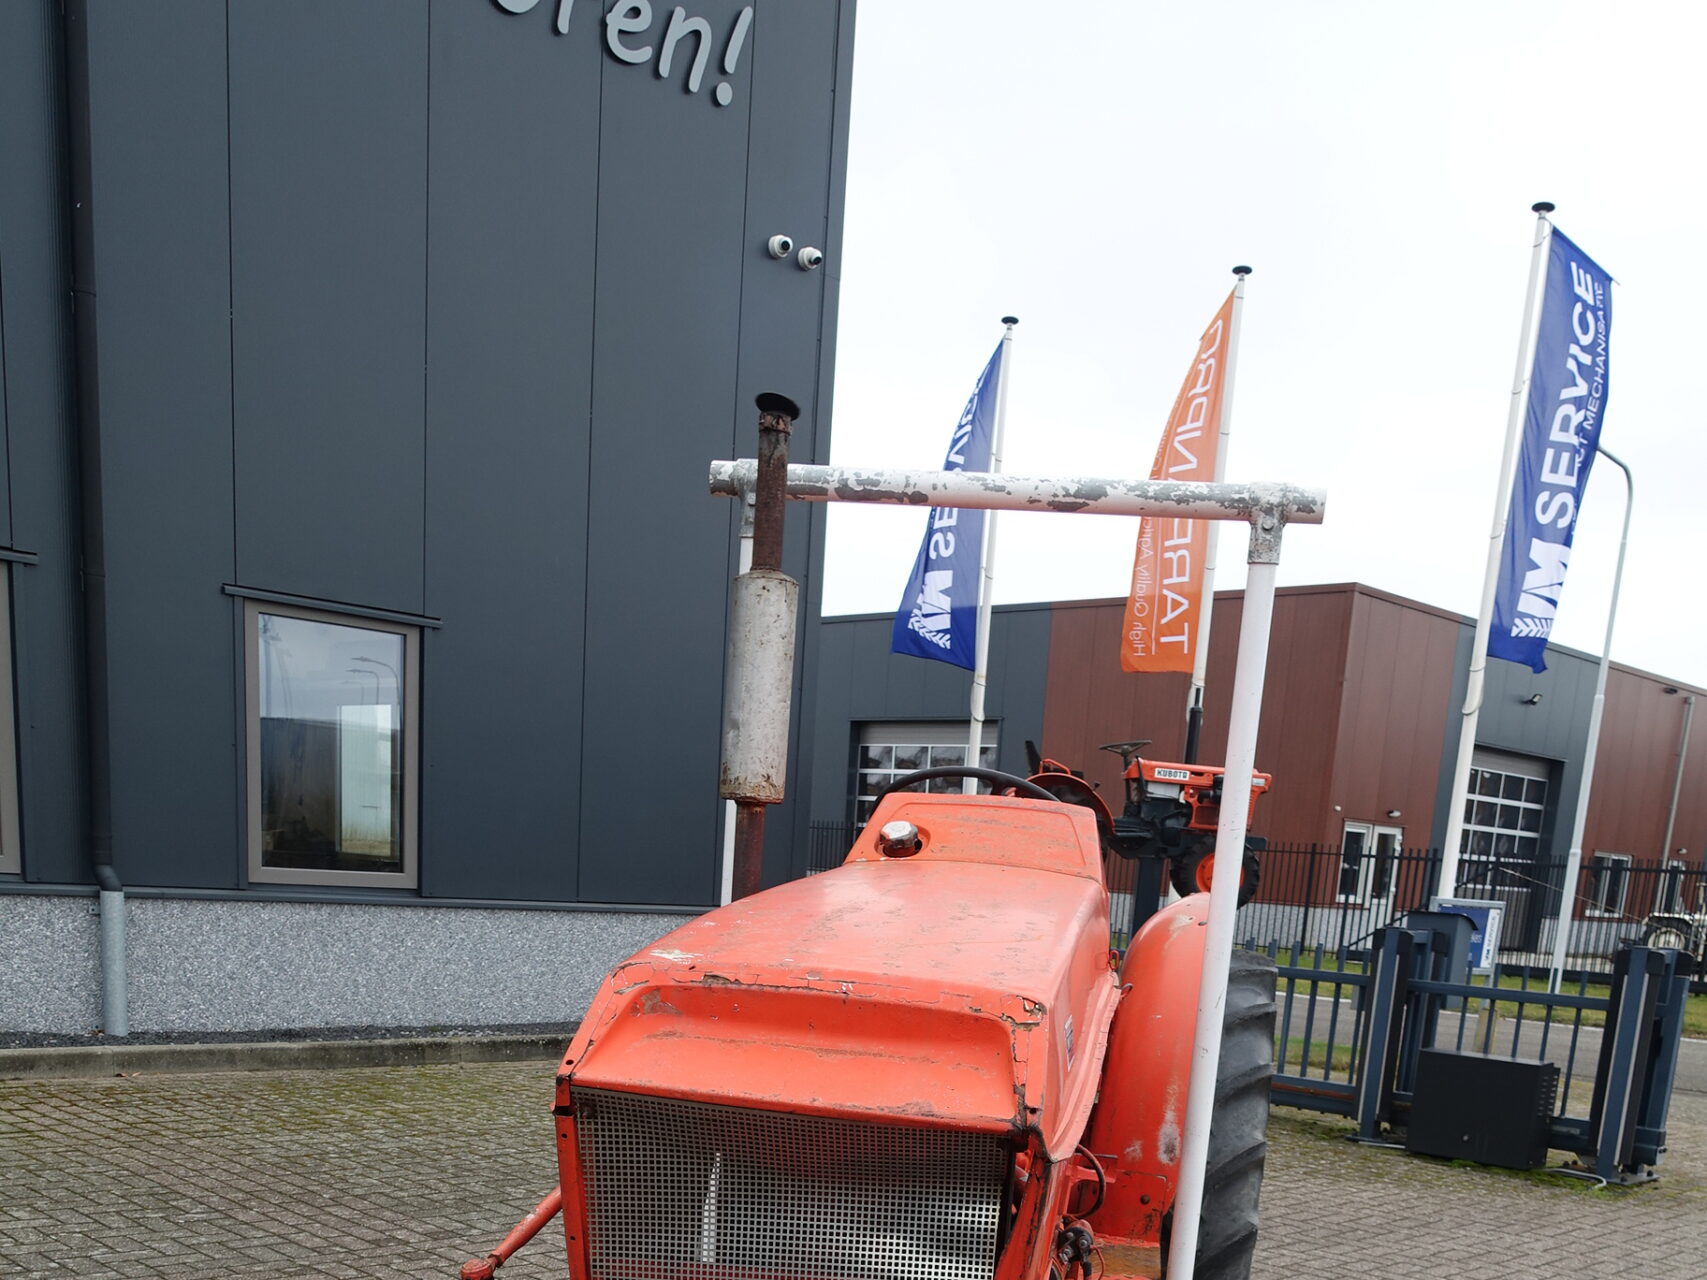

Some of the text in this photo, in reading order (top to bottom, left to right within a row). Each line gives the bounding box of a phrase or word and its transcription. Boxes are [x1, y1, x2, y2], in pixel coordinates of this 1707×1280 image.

[496, 0, 753, 106] en!
[1535, 261, 1596, 528] SERVICE
[1156, 769, 1188, 779] KUBOTA
